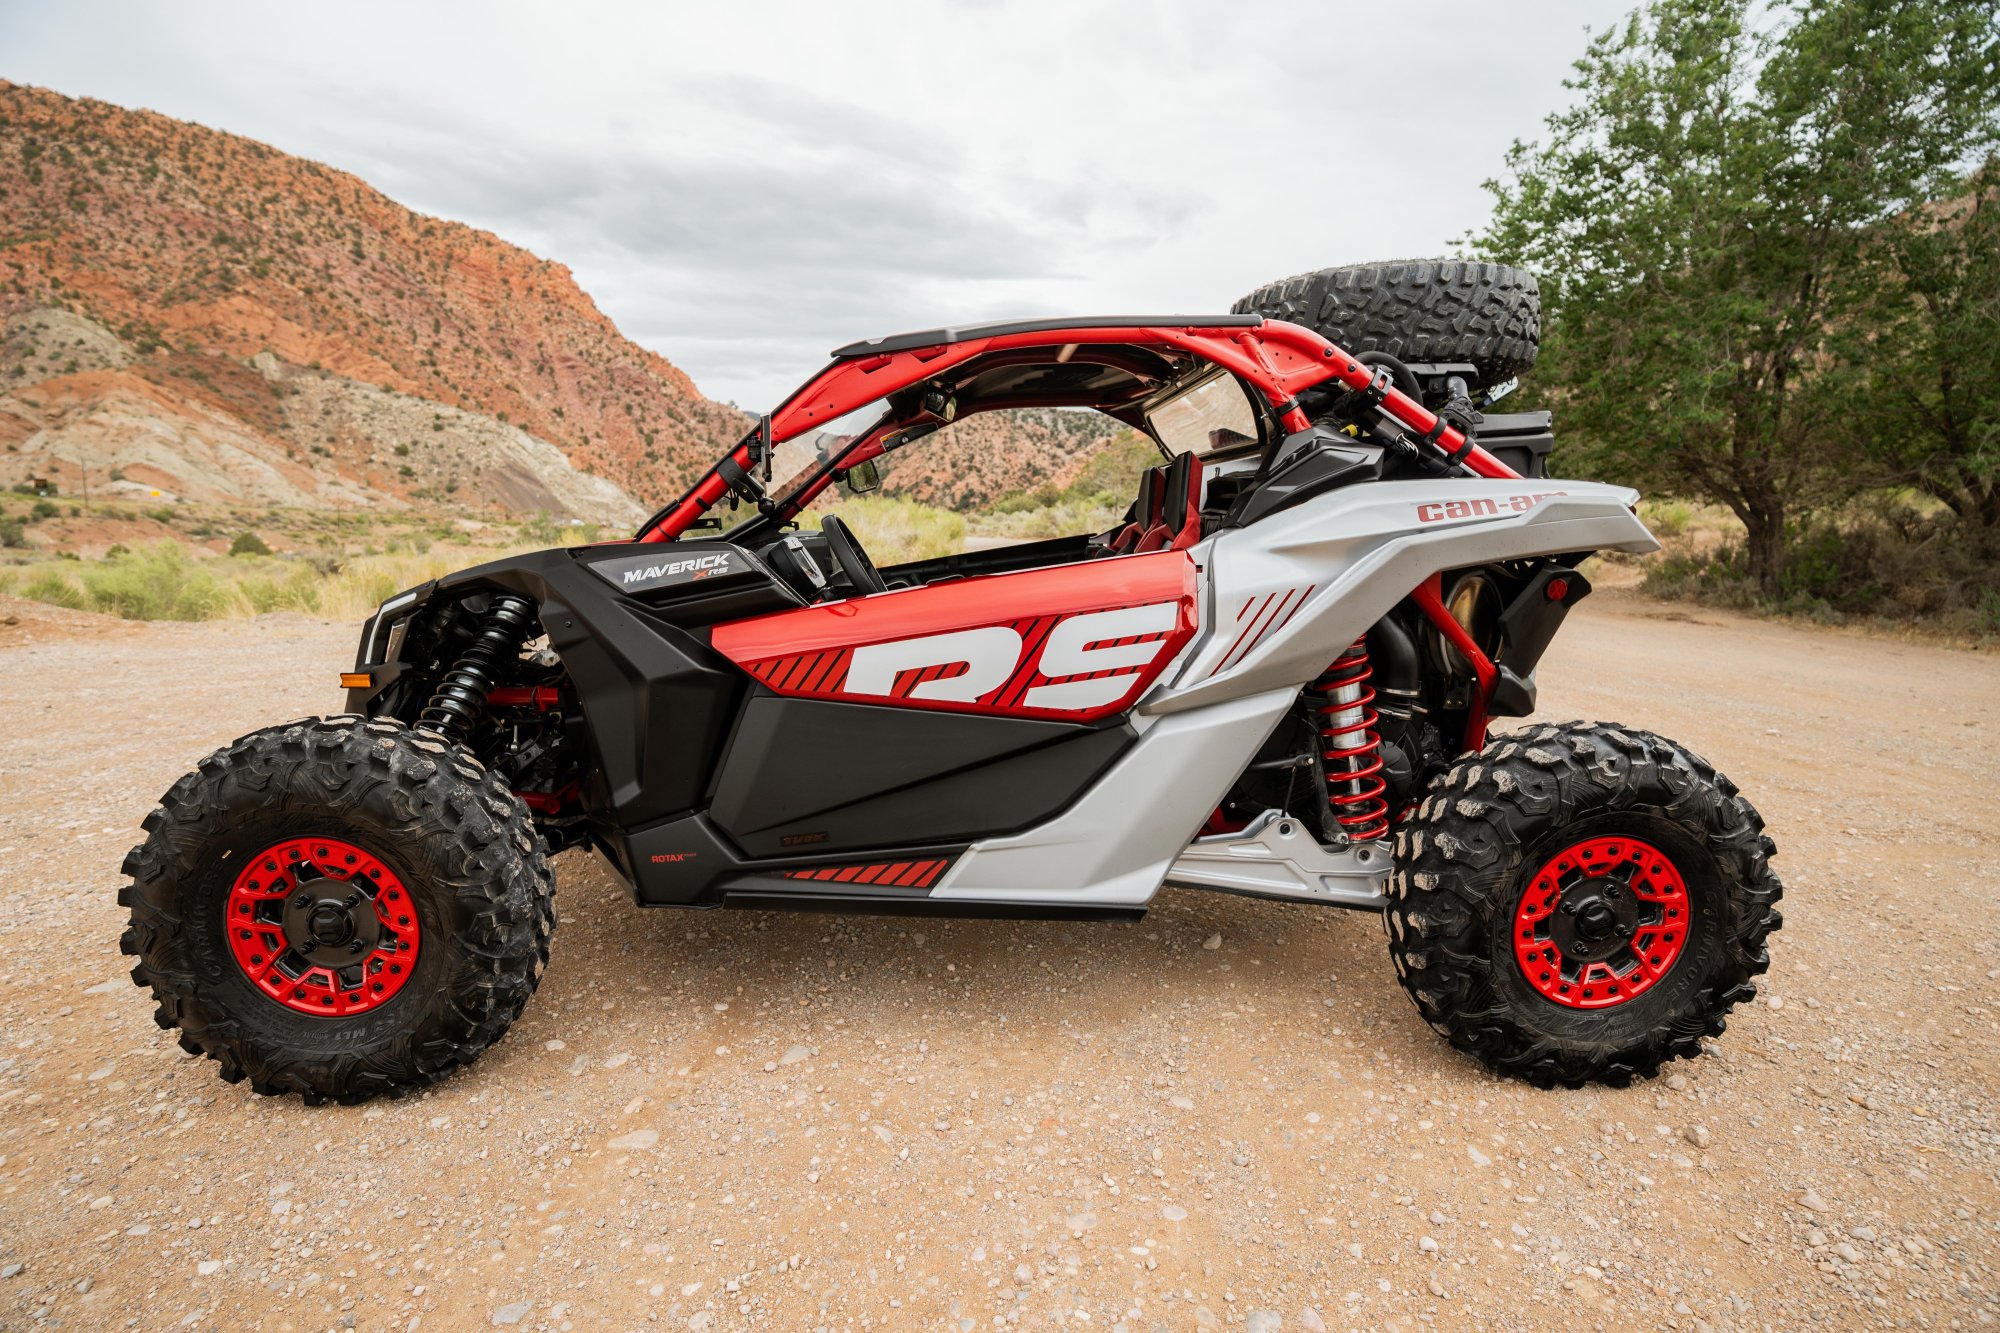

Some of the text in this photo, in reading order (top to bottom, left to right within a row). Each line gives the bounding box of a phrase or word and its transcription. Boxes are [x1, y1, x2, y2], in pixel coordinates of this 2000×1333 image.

[623, 552, 731, 583] MAVERICK
[842, 601, 1179, 710] RS
[651, 853, 685, 864] ROTAX
